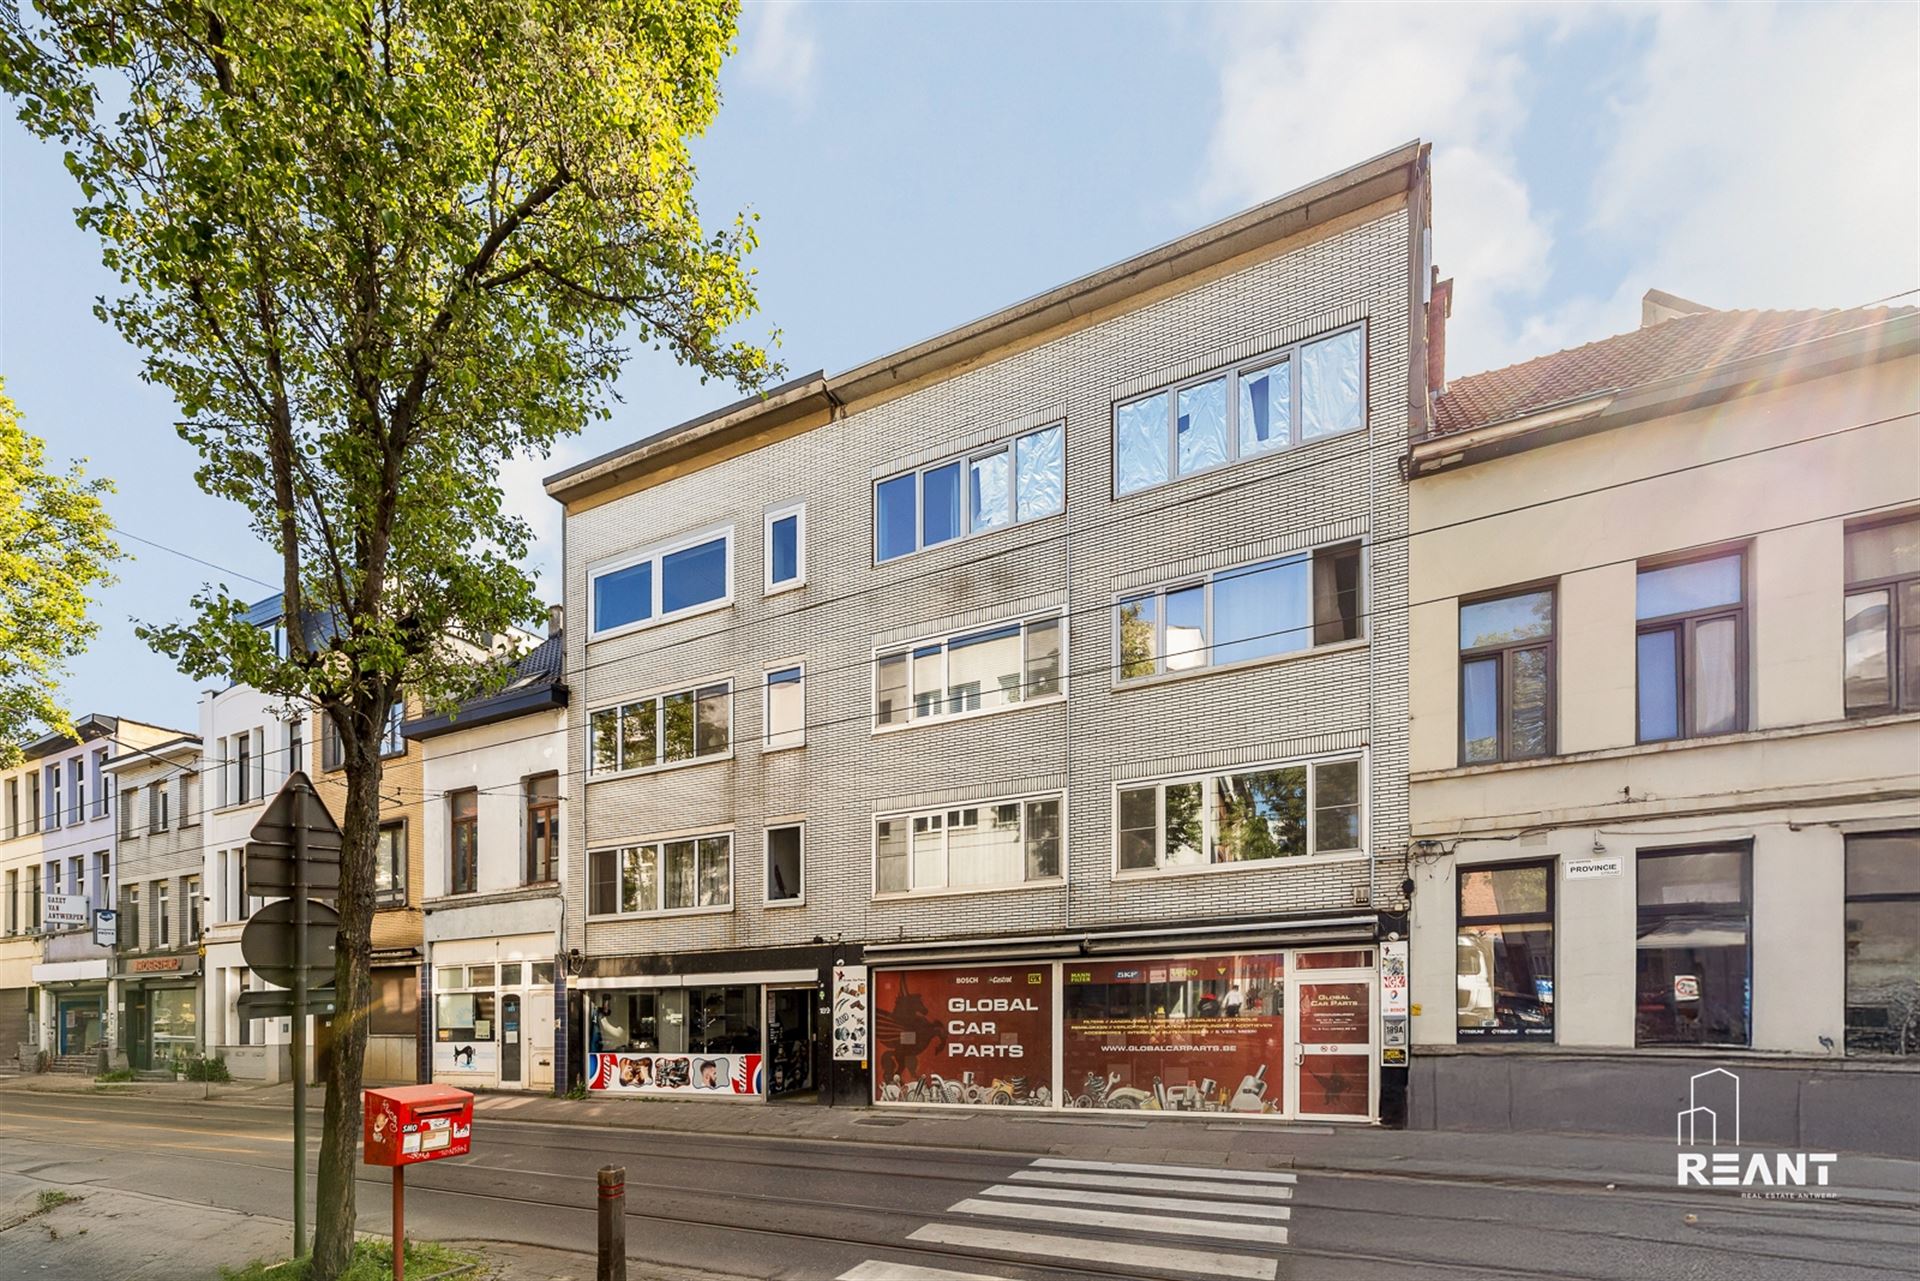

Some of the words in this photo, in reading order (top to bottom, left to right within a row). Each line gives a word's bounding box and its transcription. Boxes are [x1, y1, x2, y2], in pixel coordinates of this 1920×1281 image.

[1570, 864, 1617, 872] PROVINCIE
[48, 912, 84, 920] ANTWERPEN
[956, 976, 979, 984] BOSCH
[948, 997, 1039, 1012] GLOBAL
[948, 1020, 996, 1035] CAR
[948, 1043, 1024, 1058] PARTS
